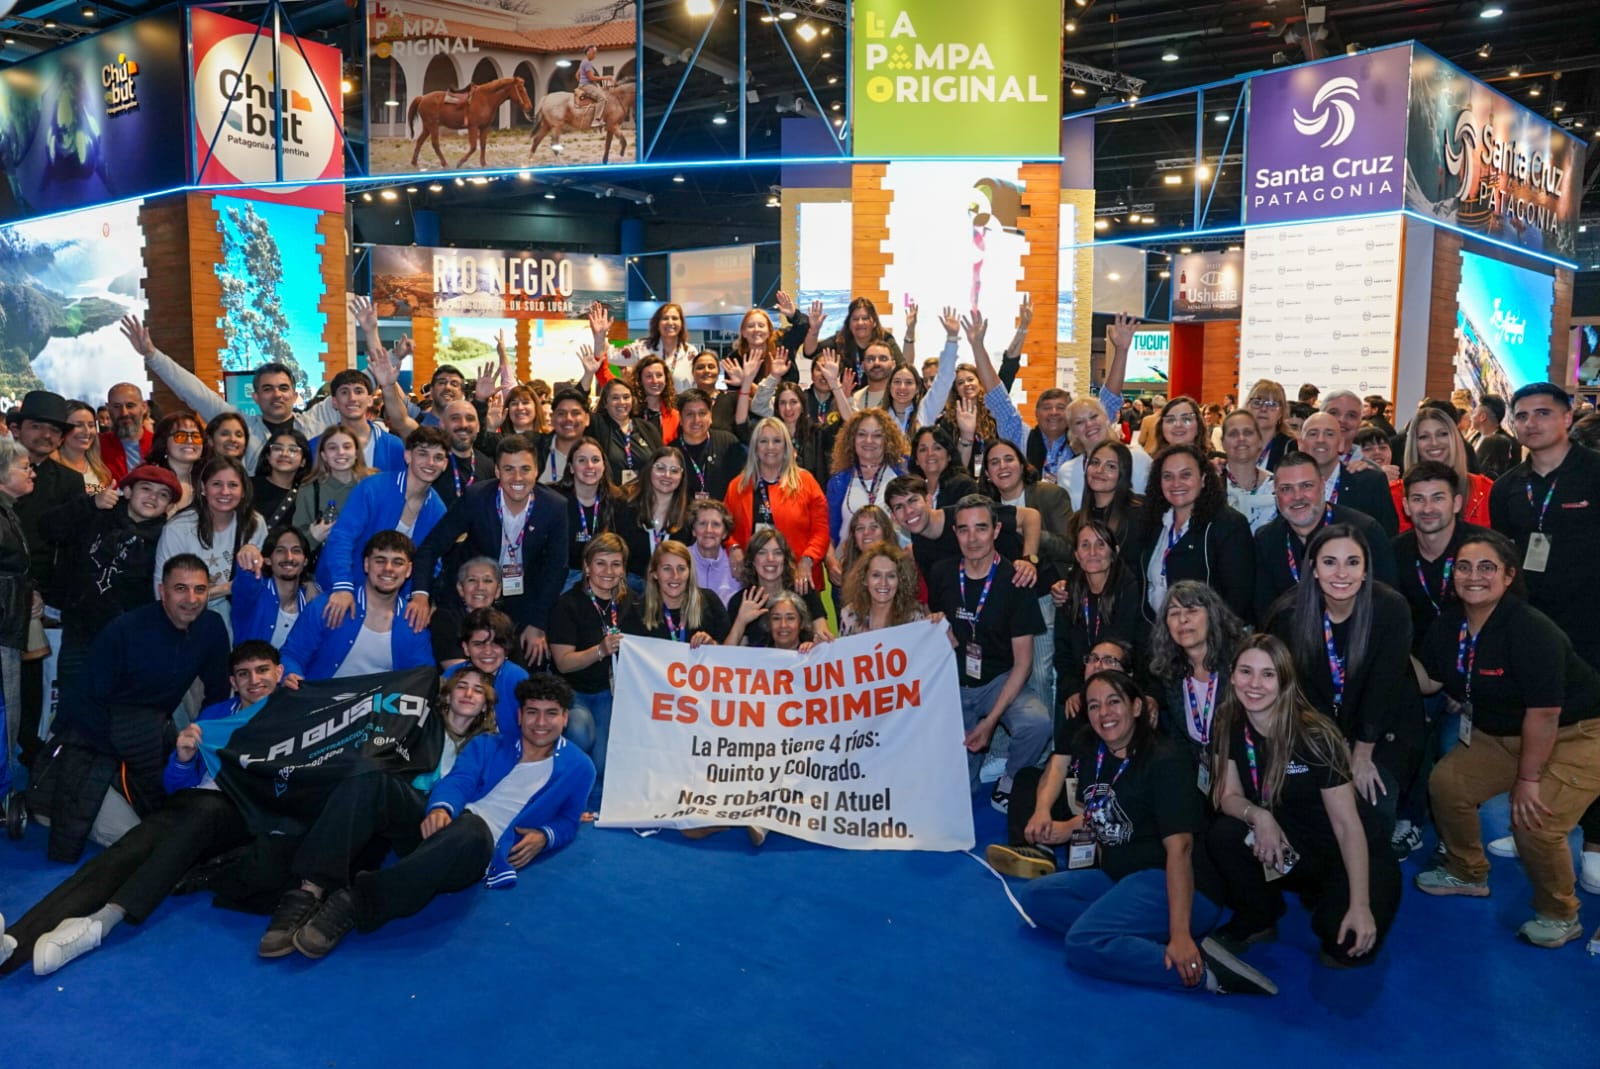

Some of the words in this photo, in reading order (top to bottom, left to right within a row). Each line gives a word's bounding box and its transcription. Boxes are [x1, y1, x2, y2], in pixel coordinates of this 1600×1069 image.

[375, 2, 404, 18] LA
[375, 18, 448, 39] PAMPA
[866, 11, 917, 38] LA
[376, 36, 480, 58] ORIGINAL
[866, 43, 995, 70] PAMPA
[866, 75, 1048, 103] ORIGINAL
[227, 135, 270, 150] Patagonia
[270, 143, 310, 158] Agentina
[1255, 163, 1325, 190] Santa
[1332, 155, 1394, 179] Cruz
[1481, 124, 1528, 183] Santa
[1531, 151, 1564, 197] Cruz
[1255, 180, 1392, 208] PATAGONIA
[1479, 181, 1559, 234] PATAGONIA
[489, 257, 573, 297] NEGRO
[525, 300, 545, 313] SOLO
[548, 301, 573, 313] LUGAR
[1188, 287, 1238, 303] Ushuaia
[667, 662, 794, 695] CORTAR
[803, 659, 845, 693] UN
[853, 642, 908, 685] RÍO
[651, 692, 699, 724] ES
[710, 699, 765, 728] UN
[777, 679, 921, 728] CRIMEN
[691, 735, 712, 757] La
[716, 737, 776, 761] Pampa
[781, 737, 825, 756] tiene
[829, 734, 841, 754] 4
[844, 729, 881, 752] ríos:
[706, 763, 765, 783] Quinto
[769, 765, 781, 783] y
[677, 789, 718, 806] Nos
[723, 787, 804, 806] robaron
[810, 791, 829, 812] el
[835, 787, 891, 812] Atuel
[715, 804, 802, 827] secaron
[807, 815, 827, 832] el
[833, 816, 914, 839] Salado.
